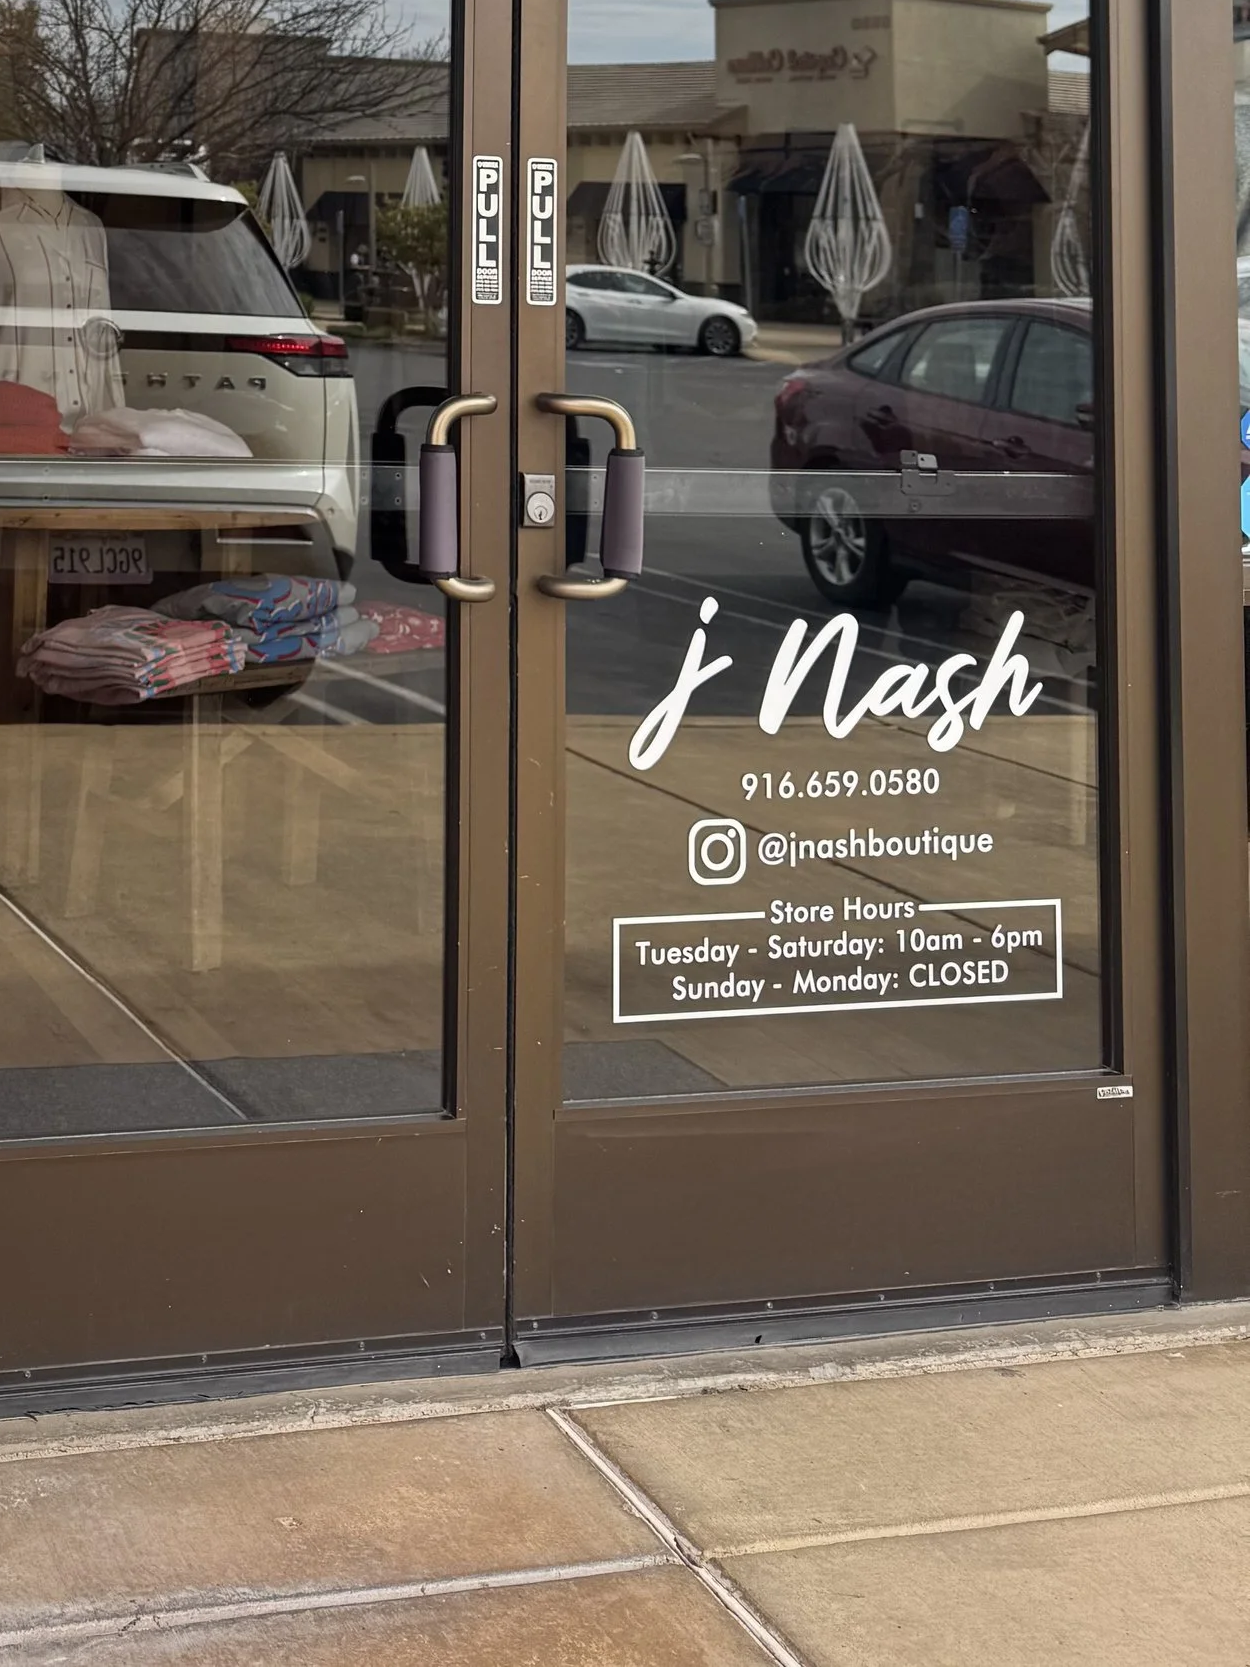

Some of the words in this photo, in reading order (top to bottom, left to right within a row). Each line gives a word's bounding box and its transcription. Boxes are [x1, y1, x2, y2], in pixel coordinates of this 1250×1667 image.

[477, 168, 499, 268] PULL
[532, 170, 554, 269] PULL
[628, 596, 733, 771] j
[758, 610, 1043, 753] Nash
[741, 768, 940, 801] 916.659.0580
[757, 826, 994, 868] @jnashboutique
[770, 899, 834, 925] Store
[843, 896, 915, 921] Hours
[635, 937, 740, 968] Tuesday
[768, 930, 884, 961] Saturday:
[896, 929, 963, 953] 10am
[991, 924, 1043, 954] 6pm
[672, 972, 766, 1003] Sunday
[792, 966, 899, 996] Monday:
[909, 959, 1009, 988] CLOSED
